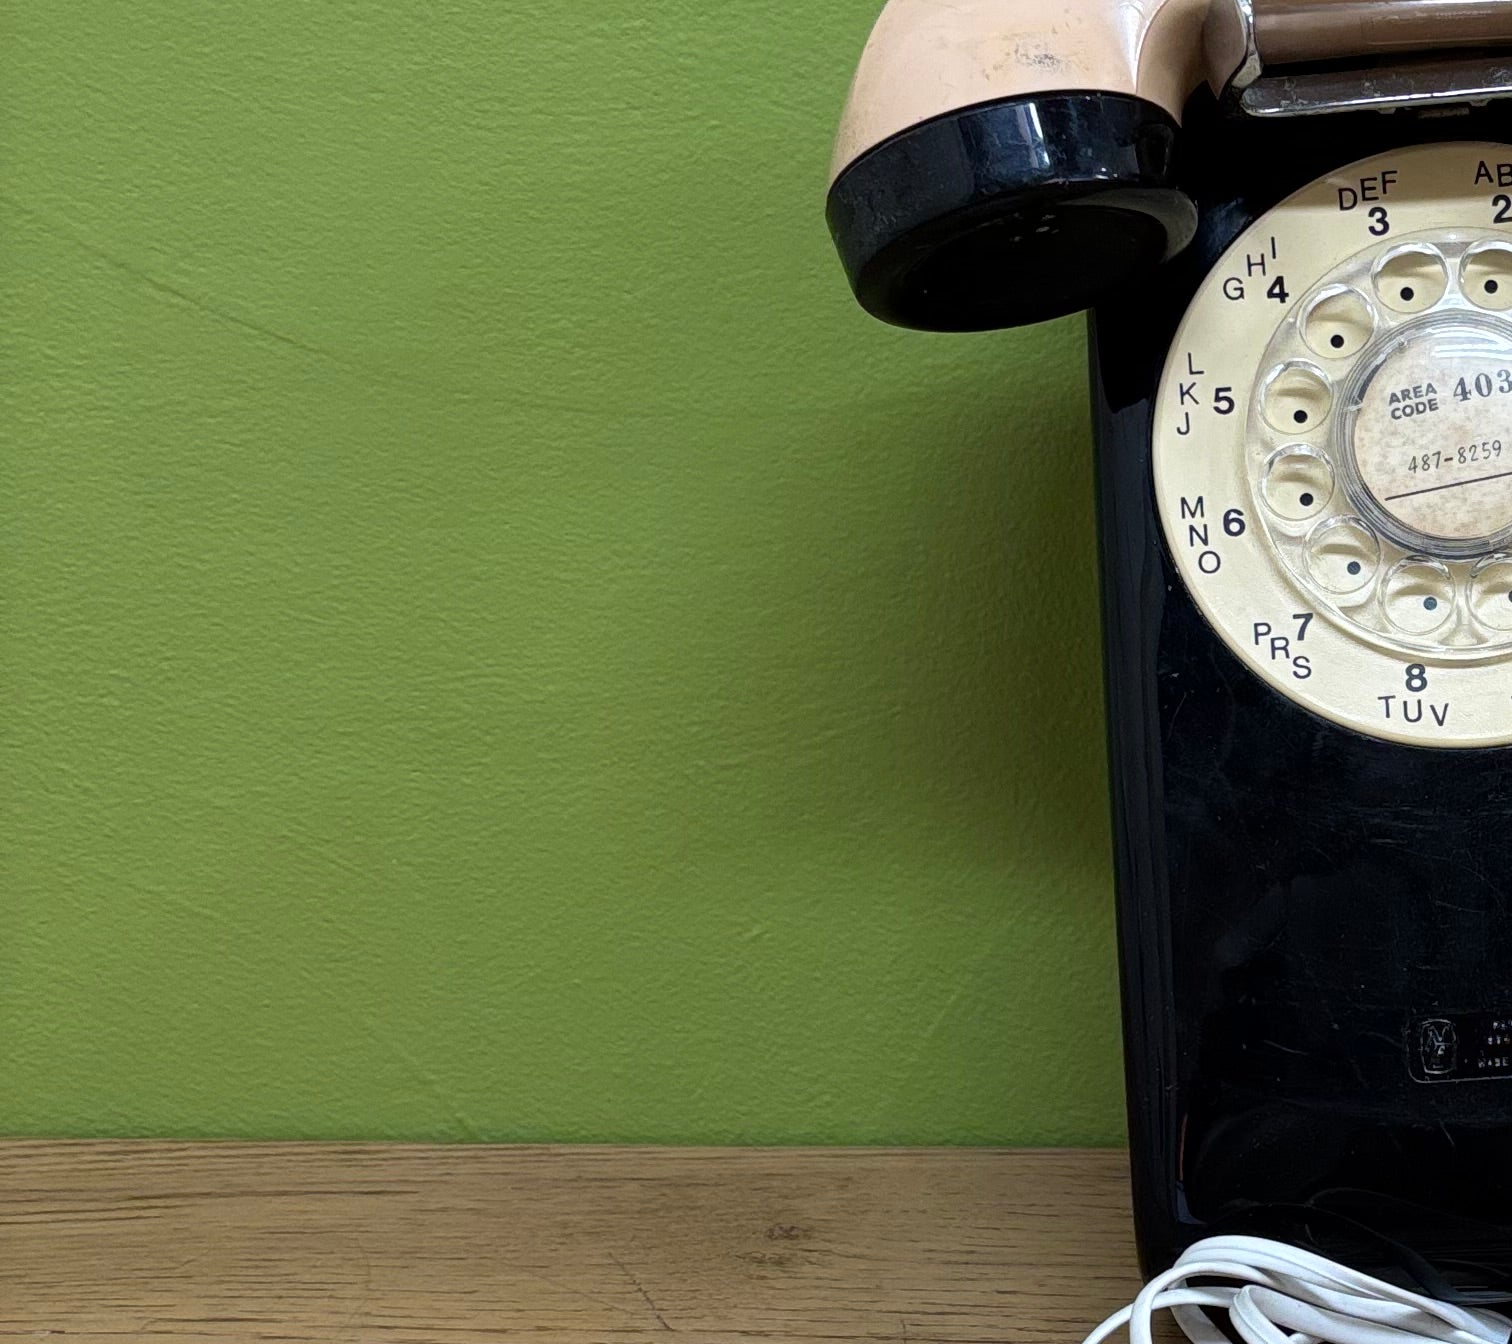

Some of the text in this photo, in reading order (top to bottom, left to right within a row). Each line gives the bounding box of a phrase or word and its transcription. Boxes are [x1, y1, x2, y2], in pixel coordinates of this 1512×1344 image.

[1338, 171, 1397, 213] DEF
[1368, 207, 1389, 236] 3
[1492, 195, 1512, 224] 2
[1267, 276, 1289, 304] 4
[1213, 387, 1236, 415] 5
[1388, 382, 1438, 406] AREA
[1390, 397, 1440, 420] CODE
[1407, 439, 1502, 474] 487-8259
[1223, 509, 1246, 537] 6
[1293, 613, 1314, 642] 7
[1405, 663, 1429, 693] 8
[1378, 695, 1449, 727] TUV
